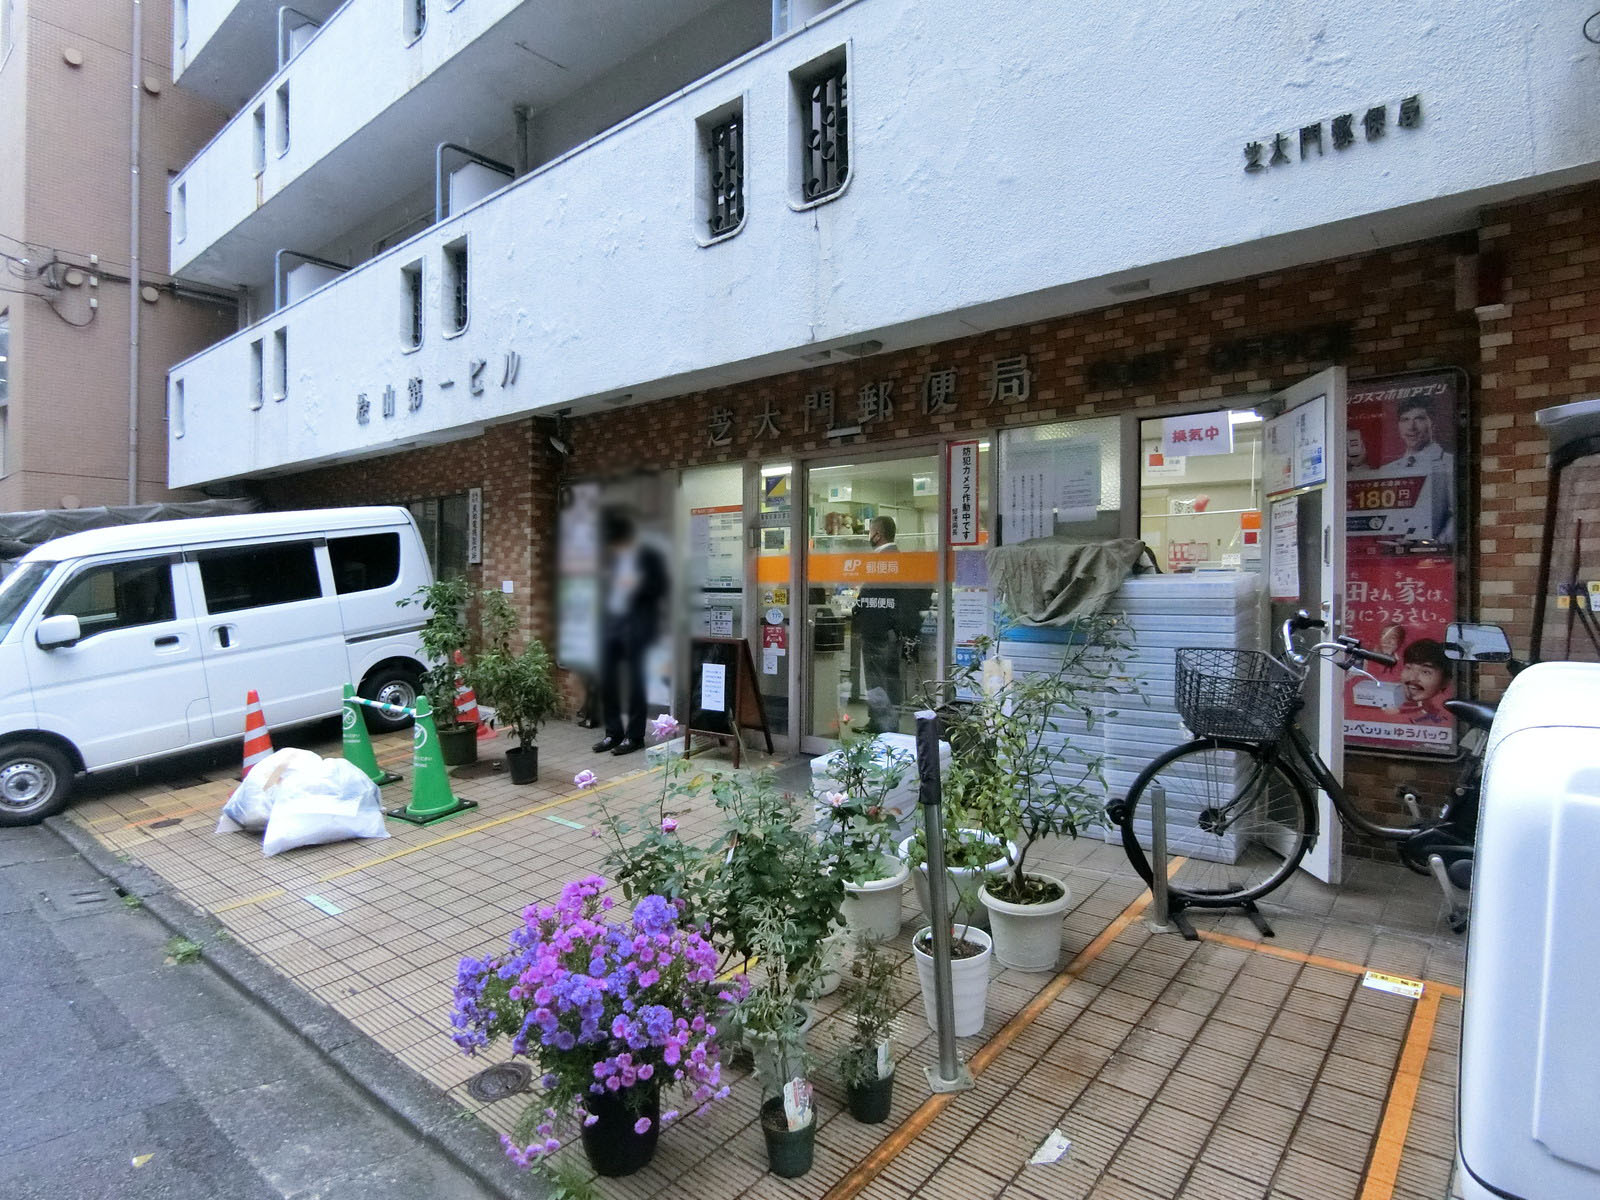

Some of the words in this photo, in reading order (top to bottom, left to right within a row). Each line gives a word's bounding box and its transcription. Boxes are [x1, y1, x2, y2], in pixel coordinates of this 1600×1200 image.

[1243, 93, 1423, 173] 芝大門郵便局
[707, 354, 1033, 446] 芝大門郵便局
[1172, 425, 1219, 444] 換気中
[962, 447, 972, 541] 防犯カメラ作動中です
[866, 561, 900, 574] 郵便局
